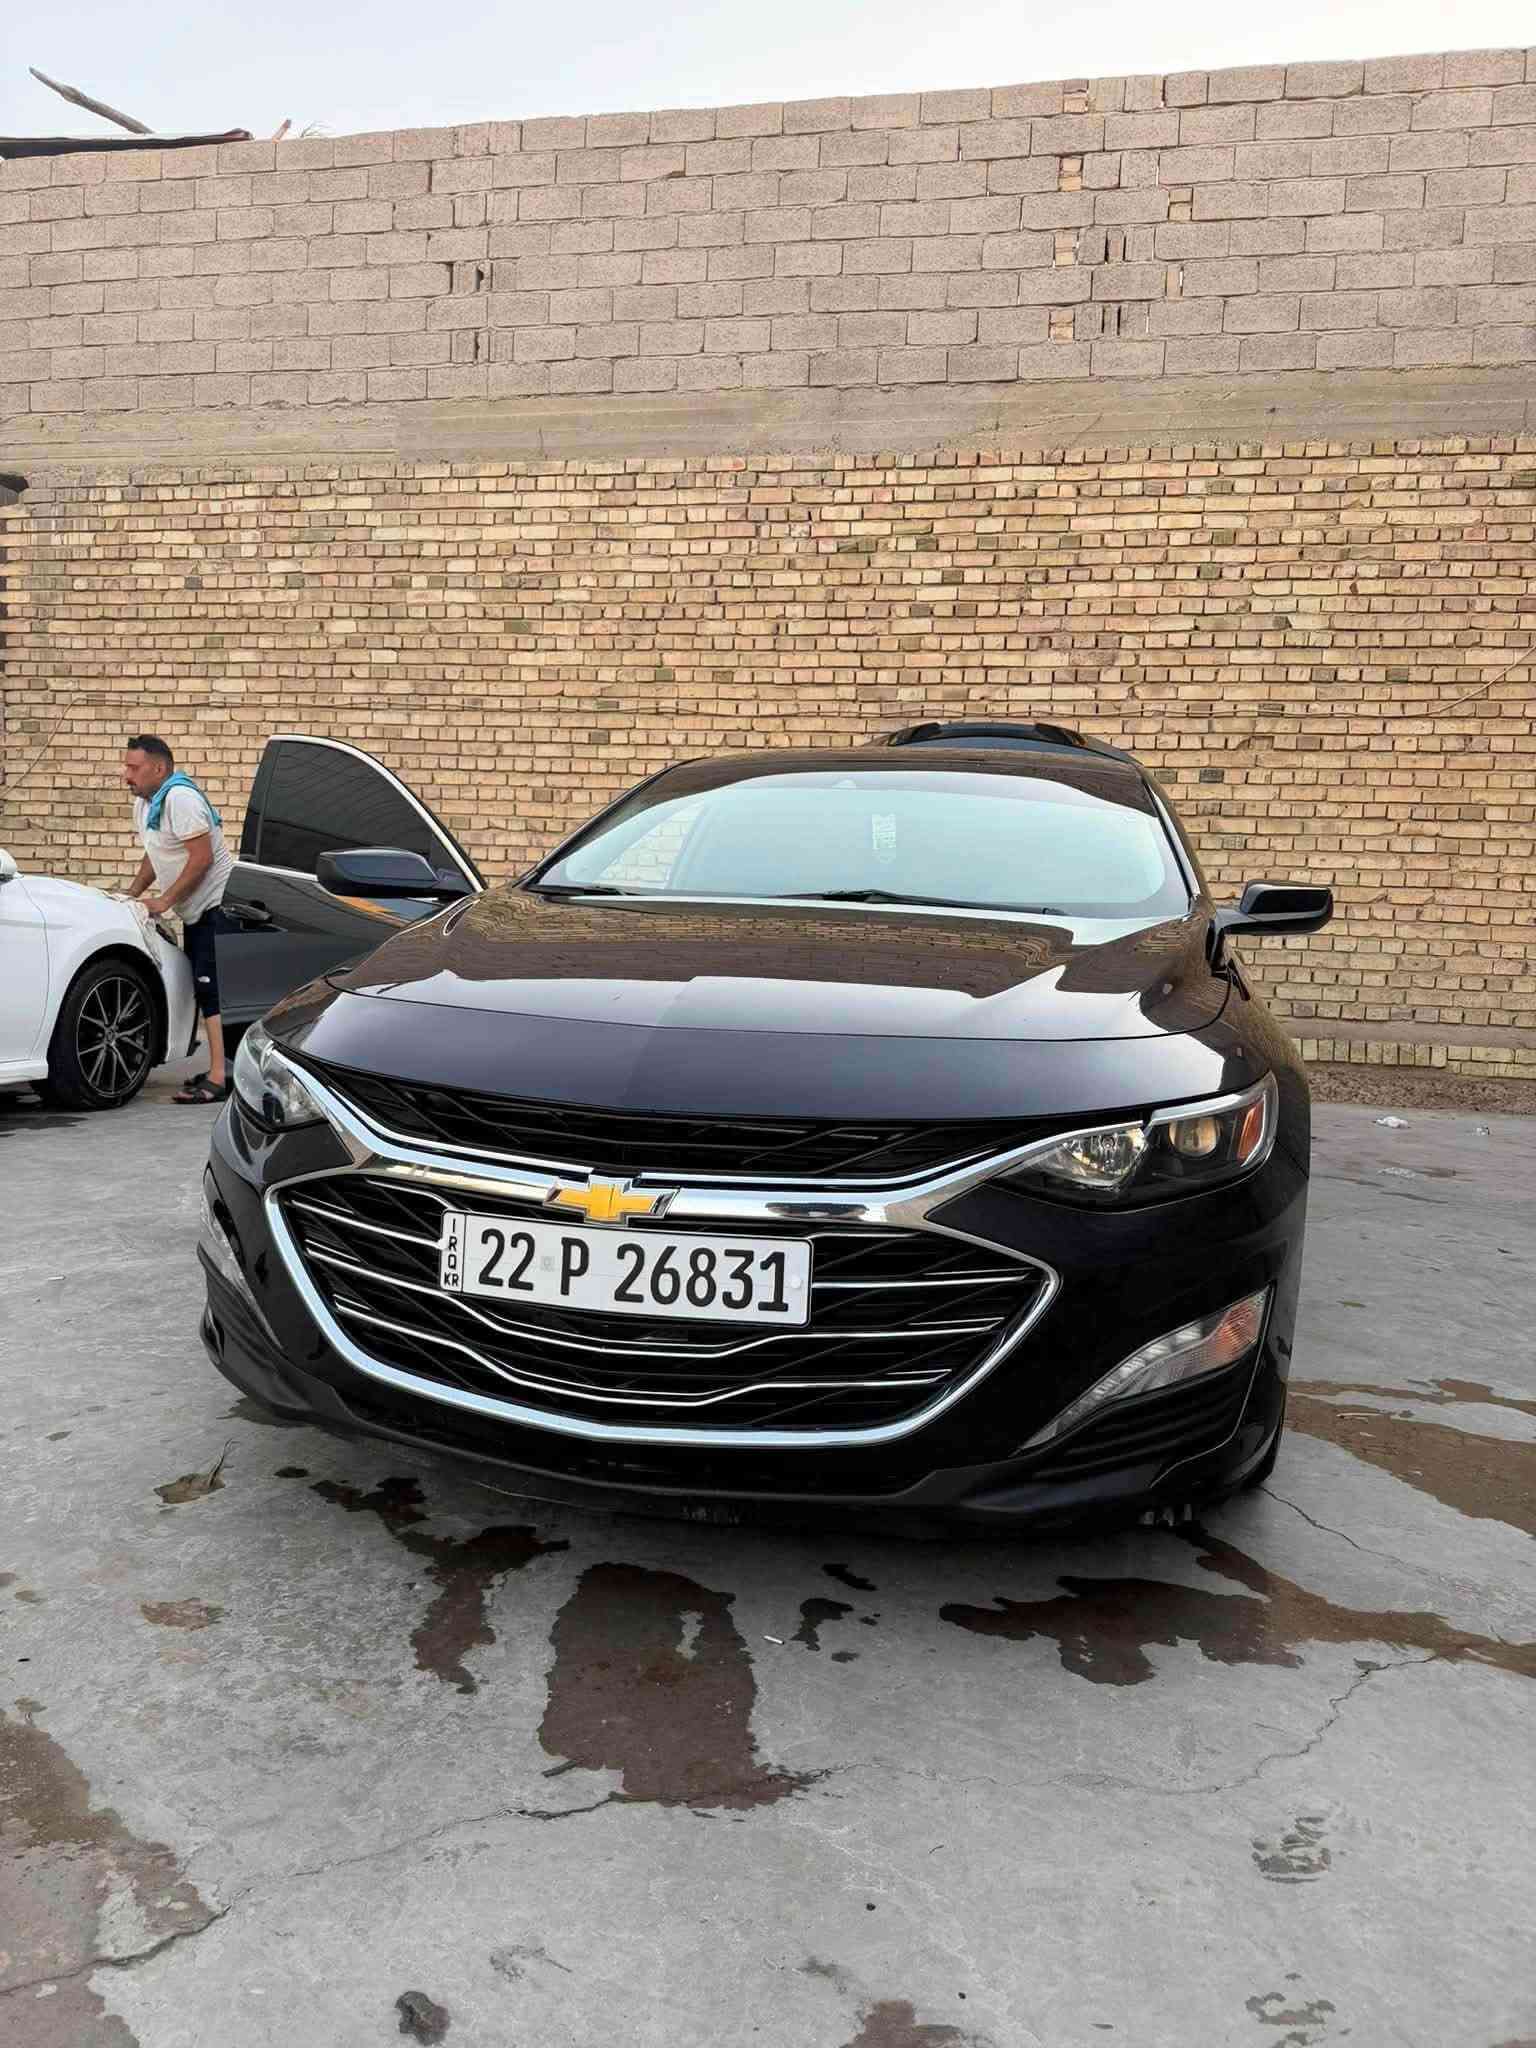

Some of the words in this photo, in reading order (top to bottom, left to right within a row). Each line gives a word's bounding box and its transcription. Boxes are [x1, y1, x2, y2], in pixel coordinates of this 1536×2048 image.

[447, 1217, 458, 1271] IRQ
[479, 1228, 536, 1292] 22
[560, 1236, 590, 1296] P
[613, 1243, 789, 1313] 26831
[443, 1272, 460, 1287] KR
